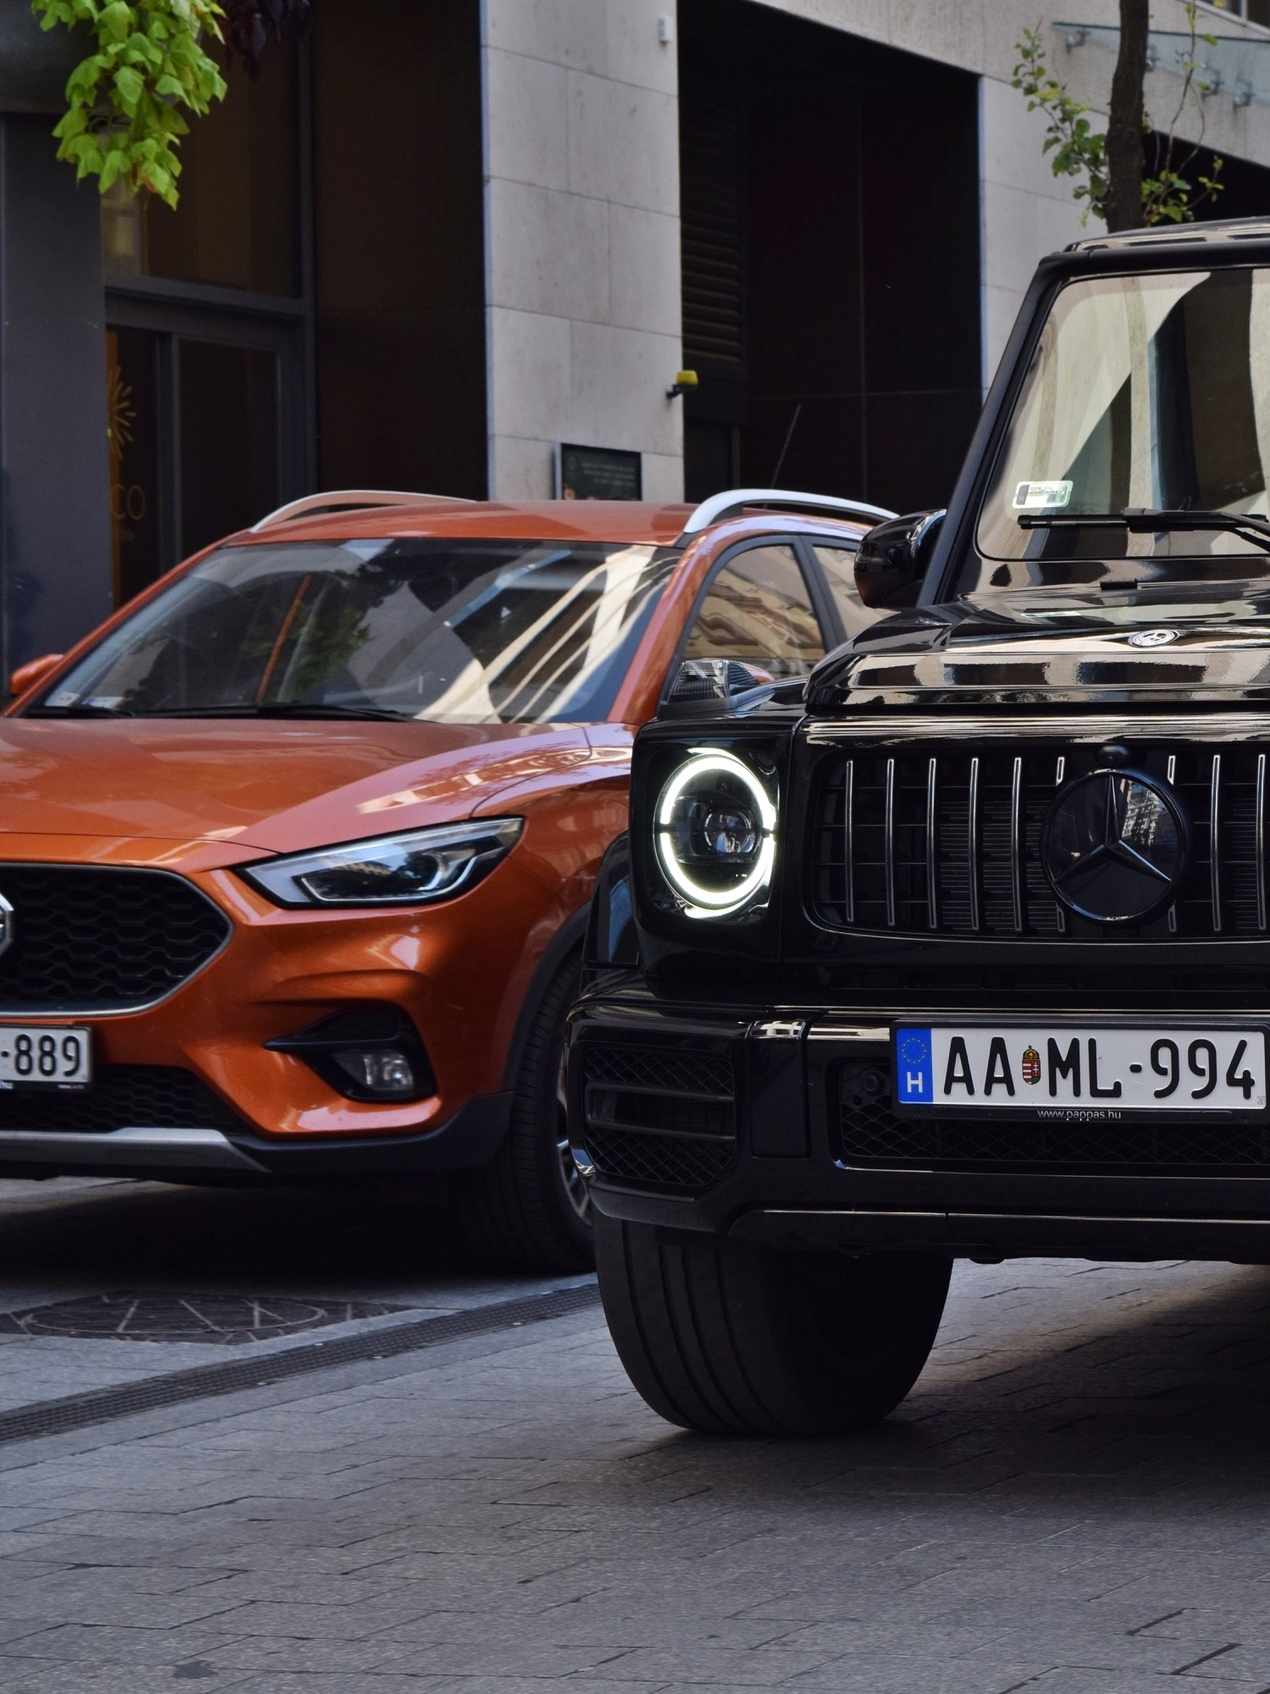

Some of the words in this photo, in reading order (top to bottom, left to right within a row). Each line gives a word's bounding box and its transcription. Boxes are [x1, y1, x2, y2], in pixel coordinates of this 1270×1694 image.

[943, 1036, 1016, 1096] AA
[1047, 1037, 1256, 1100] ML-994
[906, 1071, 923, 1093] H
[1037, 1109, 1121, 1122] www.pappas.hu
